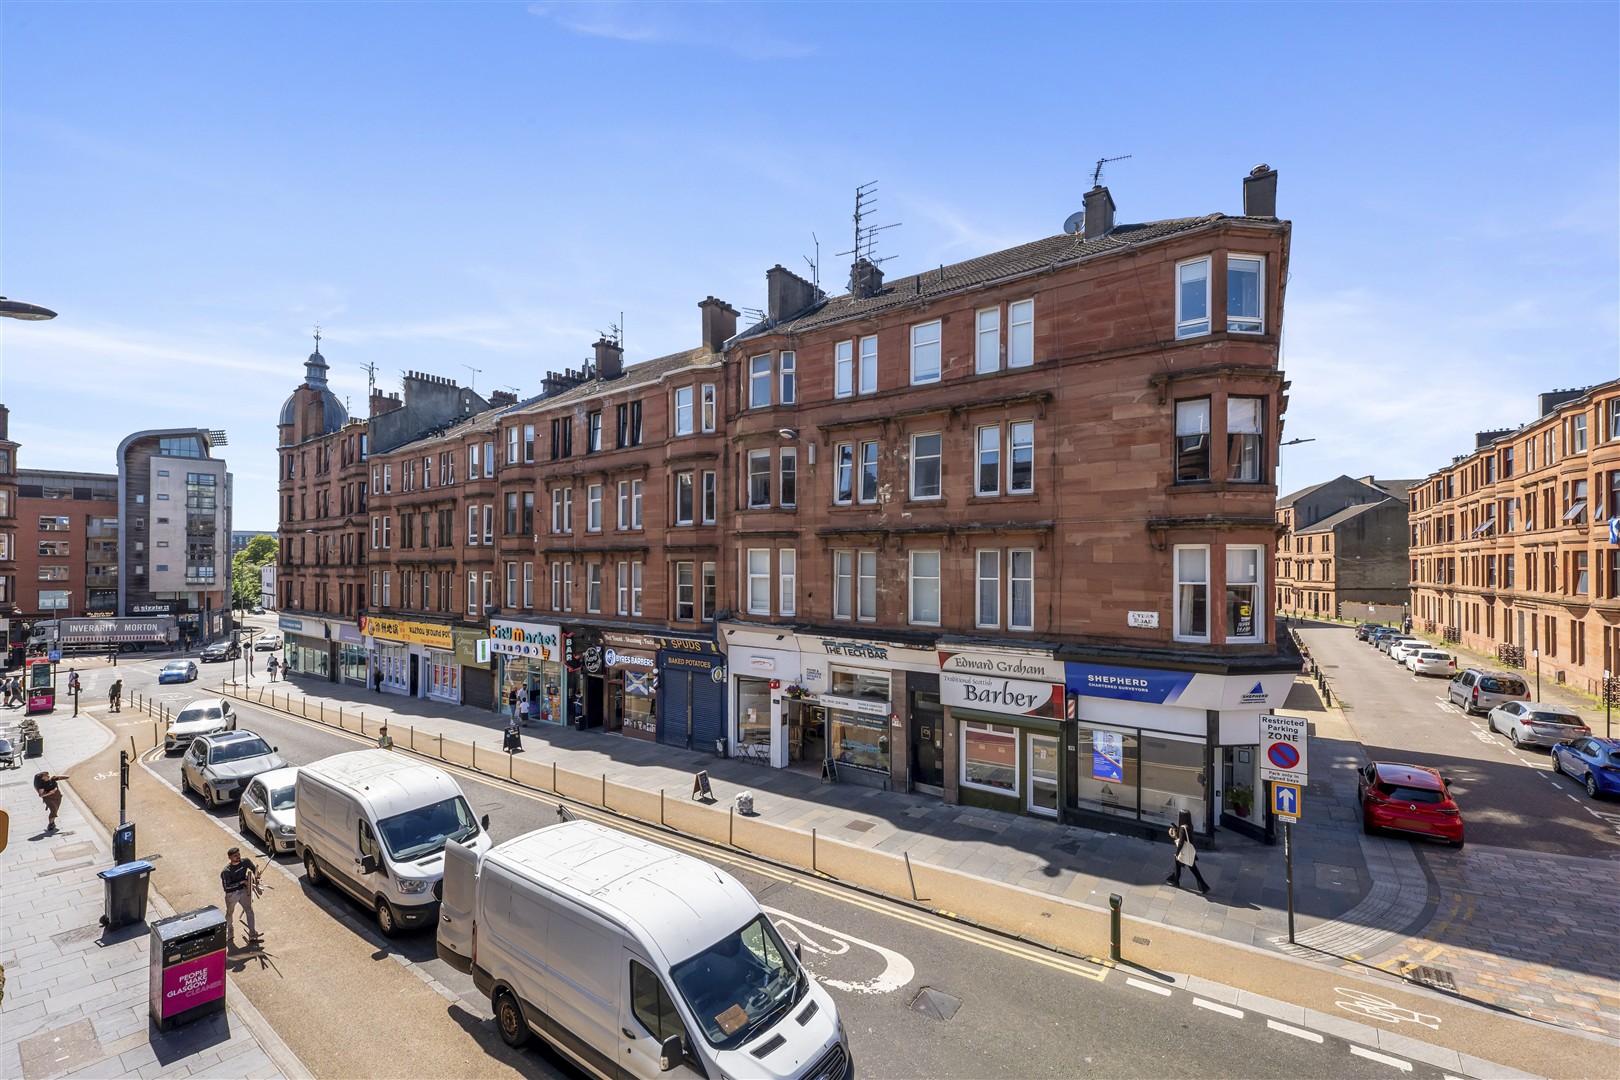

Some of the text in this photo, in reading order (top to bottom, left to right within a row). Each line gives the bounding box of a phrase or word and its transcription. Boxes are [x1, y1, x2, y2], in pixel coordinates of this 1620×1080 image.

[70, 624, 158, 632] INVERARITY MORTON
[426, 628, 442, 638] ground
[671, 640, 702, 651] SPUDS
[823, 644, 888, 660] THE TECH BAR
[616, 654, 654, 666] BYRES BARBERS
[686, 660, 712, 668] POTATOES
[954, 657, 1045, 676] Edward Graham
[944, 676, 992, 686] Traditional Scottish
[1088, 674, 1148, 686] SHEPHERD
[963, 681, 1038, 708] Barber
[1262, 716, 1304, 727] Restricted
[1268, 725, 1298, 734] Parking
[1268, 732, 1299, 742] ZONE
[179, 968, 208, 982] PEOPLE
[186, 973, 208, 986] MAKE
[167, 979, 208, 998] GLASGOW
[186, 980, 222, 997] CLEANER
